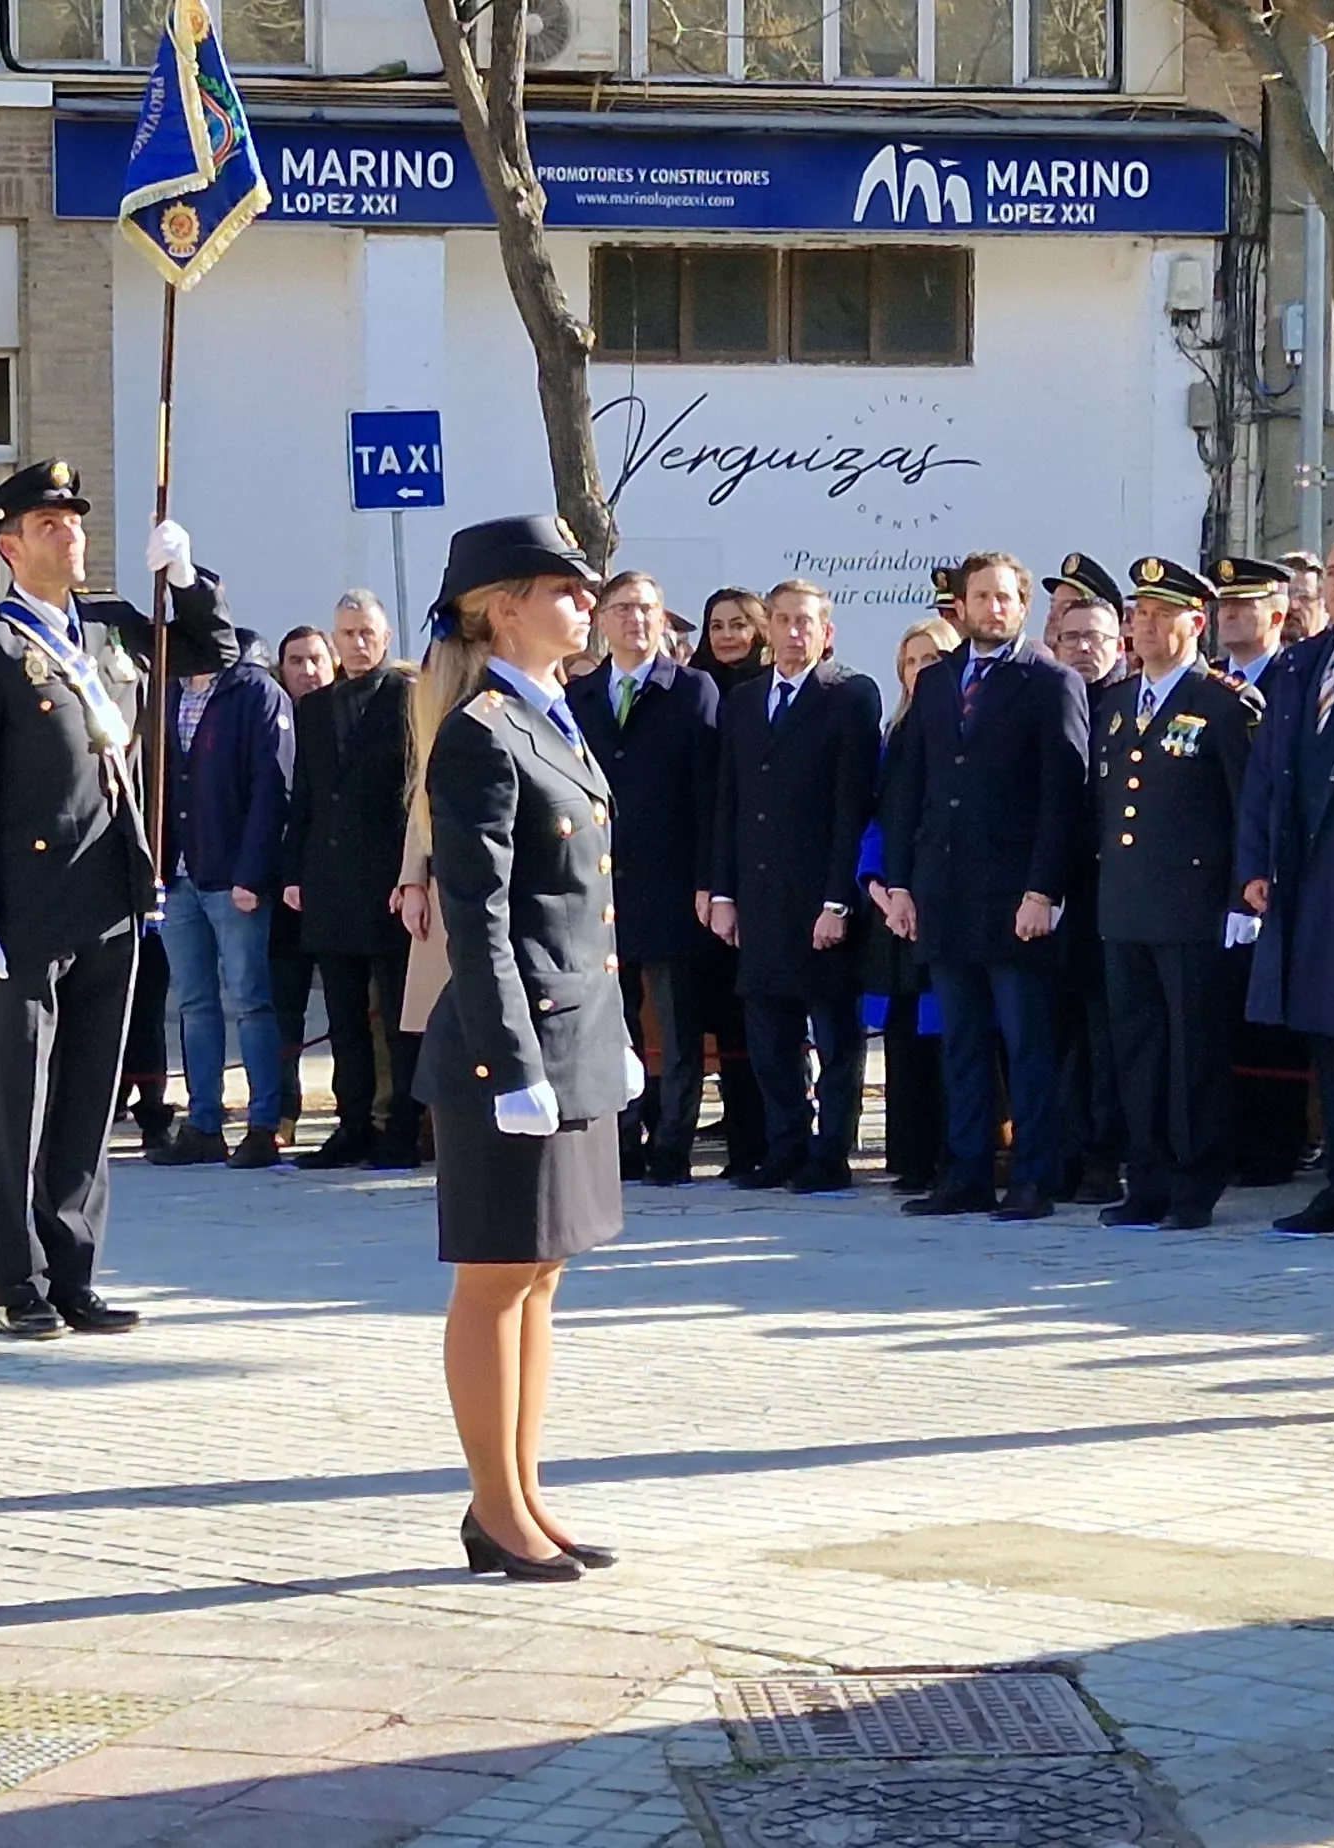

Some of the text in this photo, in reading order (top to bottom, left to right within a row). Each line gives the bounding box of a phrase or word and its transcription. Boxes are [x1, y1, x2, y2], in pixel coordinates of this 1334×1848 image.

[281, 148, 454, 189] MARINO
[537, 167, 770, 186] PROMOTORES Y CONSTRUCTORES
[987, 160, 1149, 198] MARINO
[281, 192, 397, 215] LOPEZ XXI
[575, 192, 735, 208] www.marinolopezxxi.com
[987, 203, 1095, 224] LOPEZ XXI
[354, 444, 441, 475] TAXI
[592, 393, 982, 506] Verguizas
